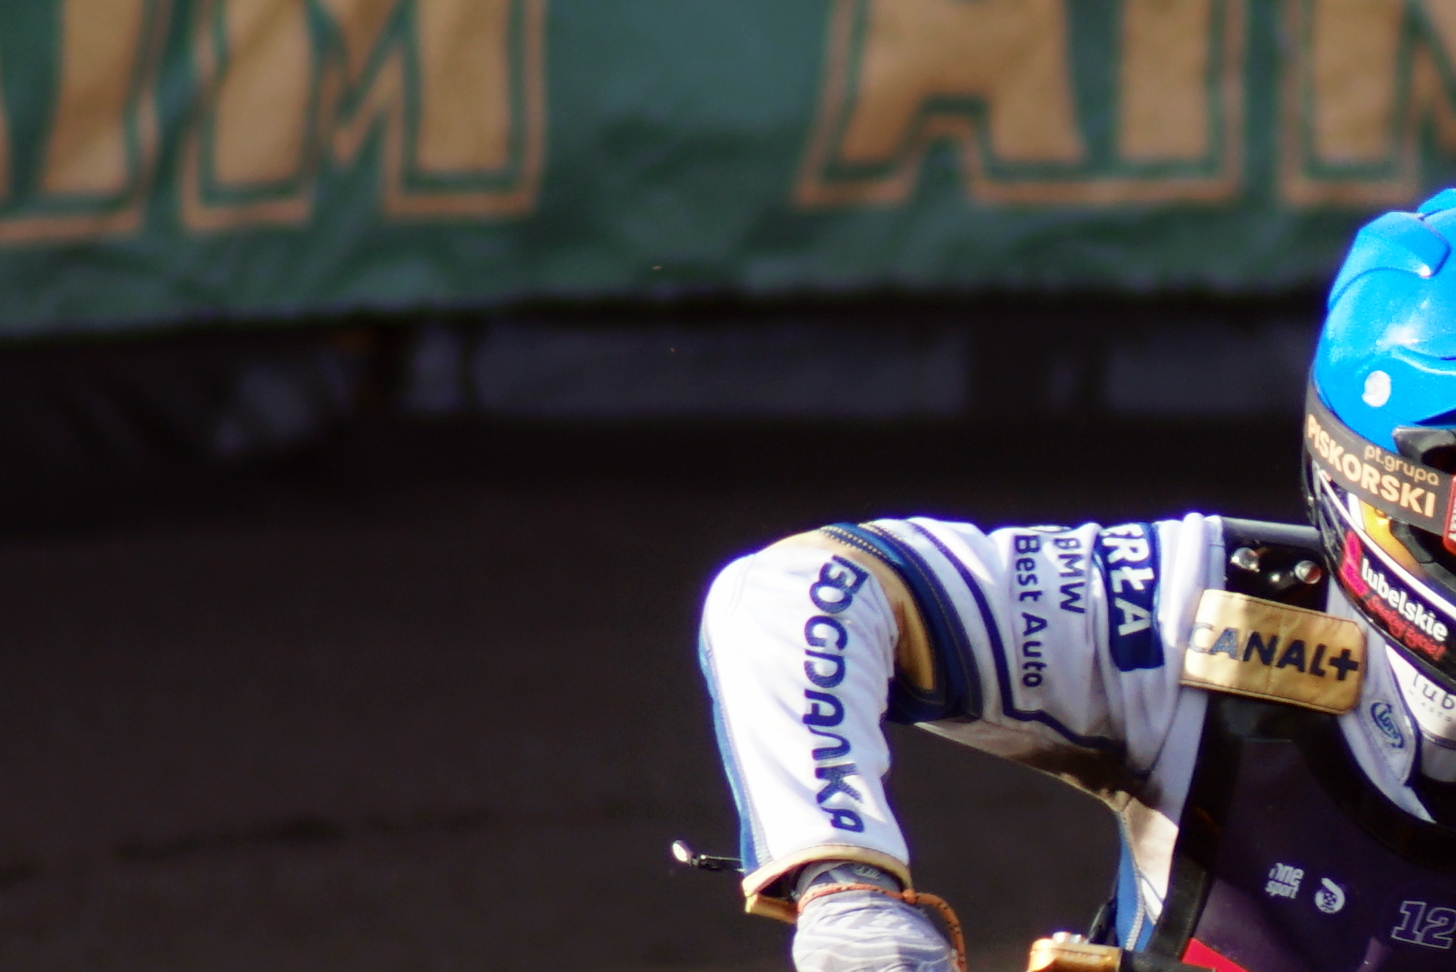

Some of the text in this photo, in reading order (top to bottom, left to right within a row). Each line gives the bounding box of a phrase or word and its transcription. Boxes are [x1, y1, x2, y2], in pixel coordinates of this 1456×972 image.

[1307, 413, 1436, 518] PISKORSKI
[1364, 444, 1439, 487] pt.grupa
[1013, 534, 1048, 688] Best Auto
[1052, 537, 1086, 614] BMW
[1361, 557, 1449, 643] lubelskie
[802, 553, 871, 833] BOGDANKA
[1188, 621, 1360, 681] CANAL+
